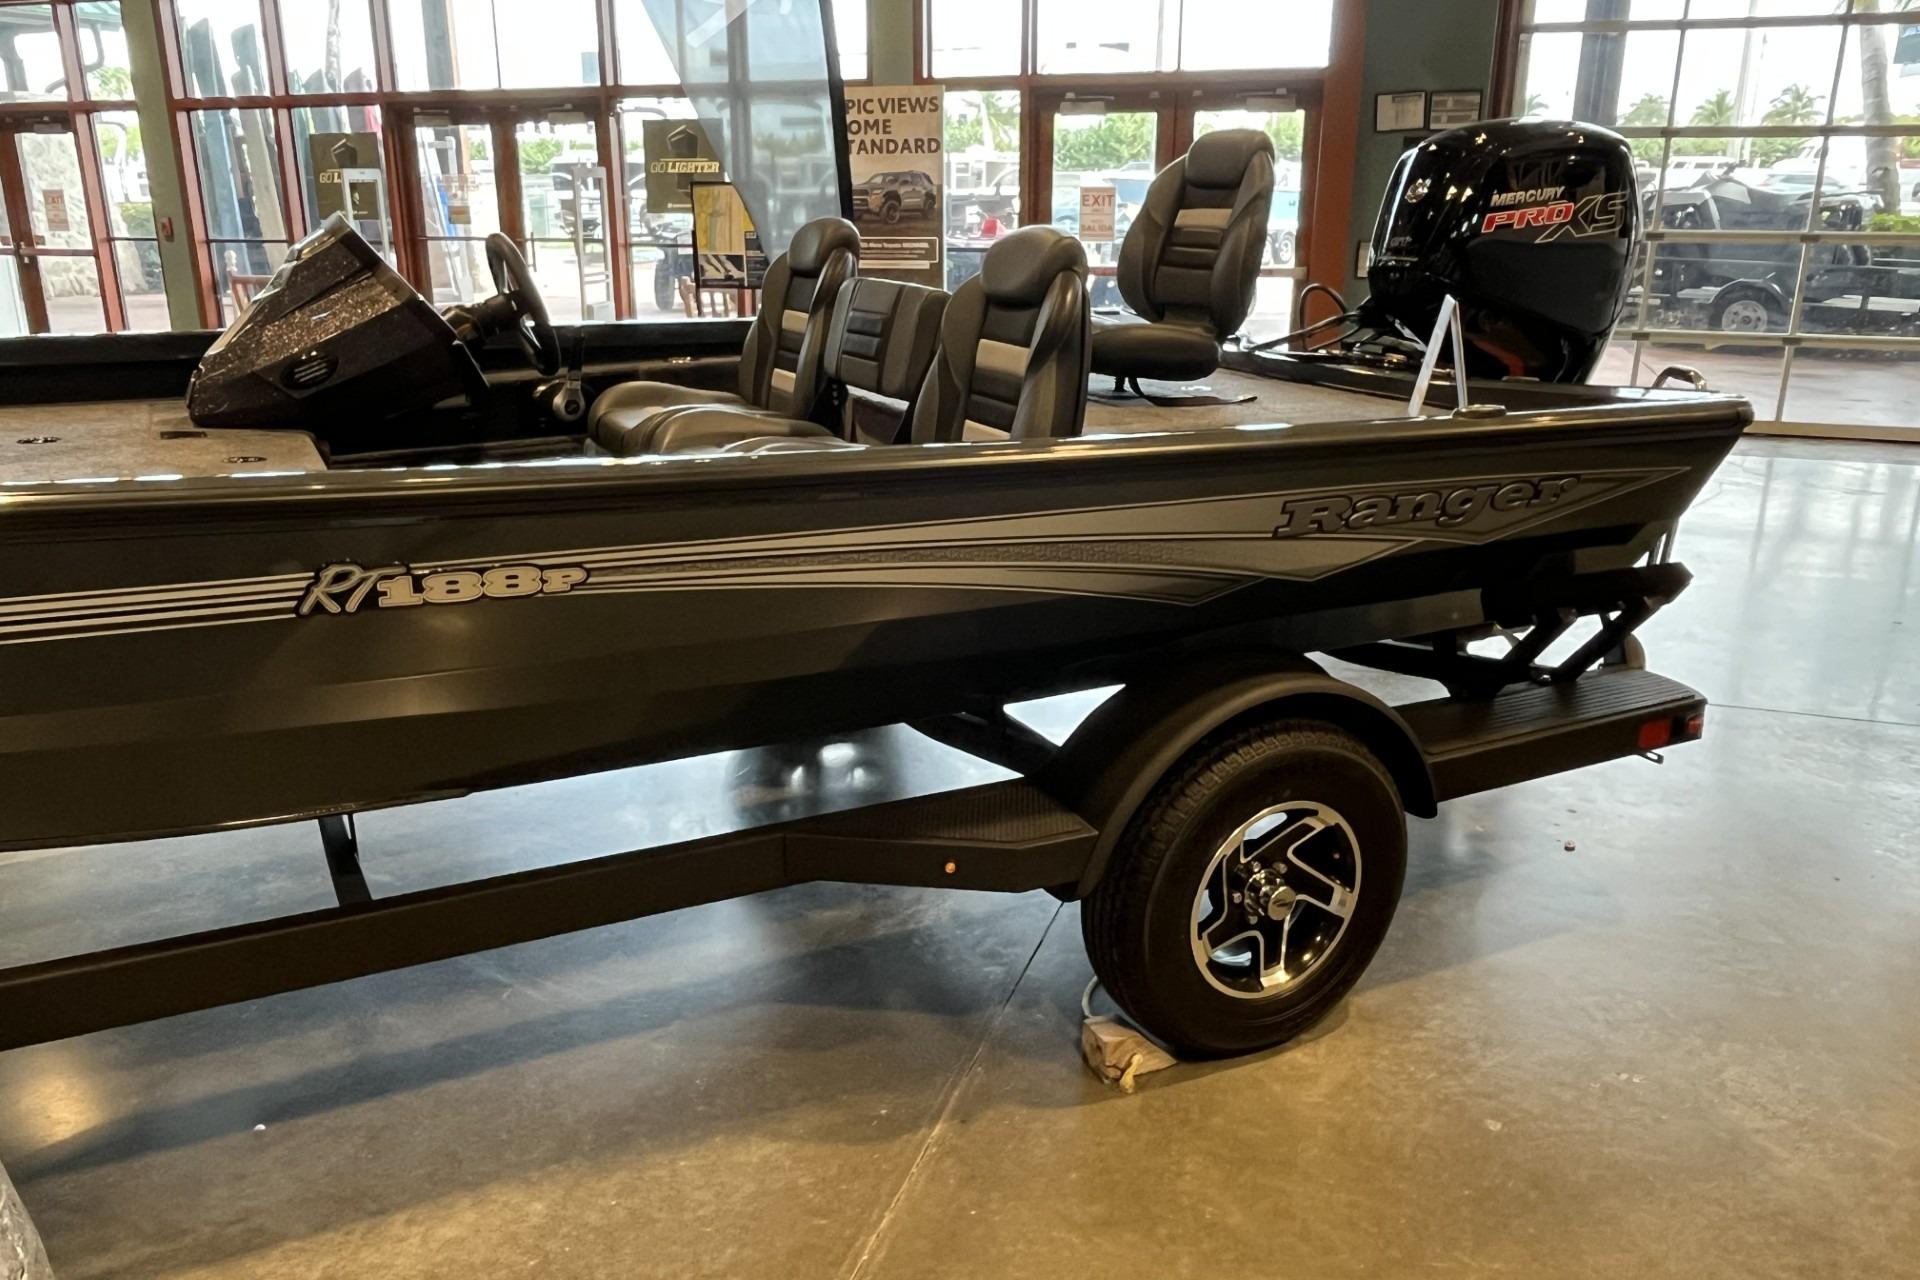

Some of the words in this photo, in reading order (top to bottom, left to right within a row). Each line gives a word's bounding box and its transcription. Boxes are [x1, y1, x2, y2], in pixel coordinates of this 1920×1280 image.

[845, 98, 874, 115] PIC
[877, 96, 939, 114] VIEWS
[847, 118, 892, 136] OME
[848, 137, 941, 156] TANDARD
[650, 162, 666, 174] GO
[667, 161, 720, 174] LIGHTER
[1082, 194, 1114, 208] EXIT
[1490, 186, 1566, 207] MERCURY
[1481, 202, 1575, 234] PRO
[1272, 475, 1581, 538] Ranger
